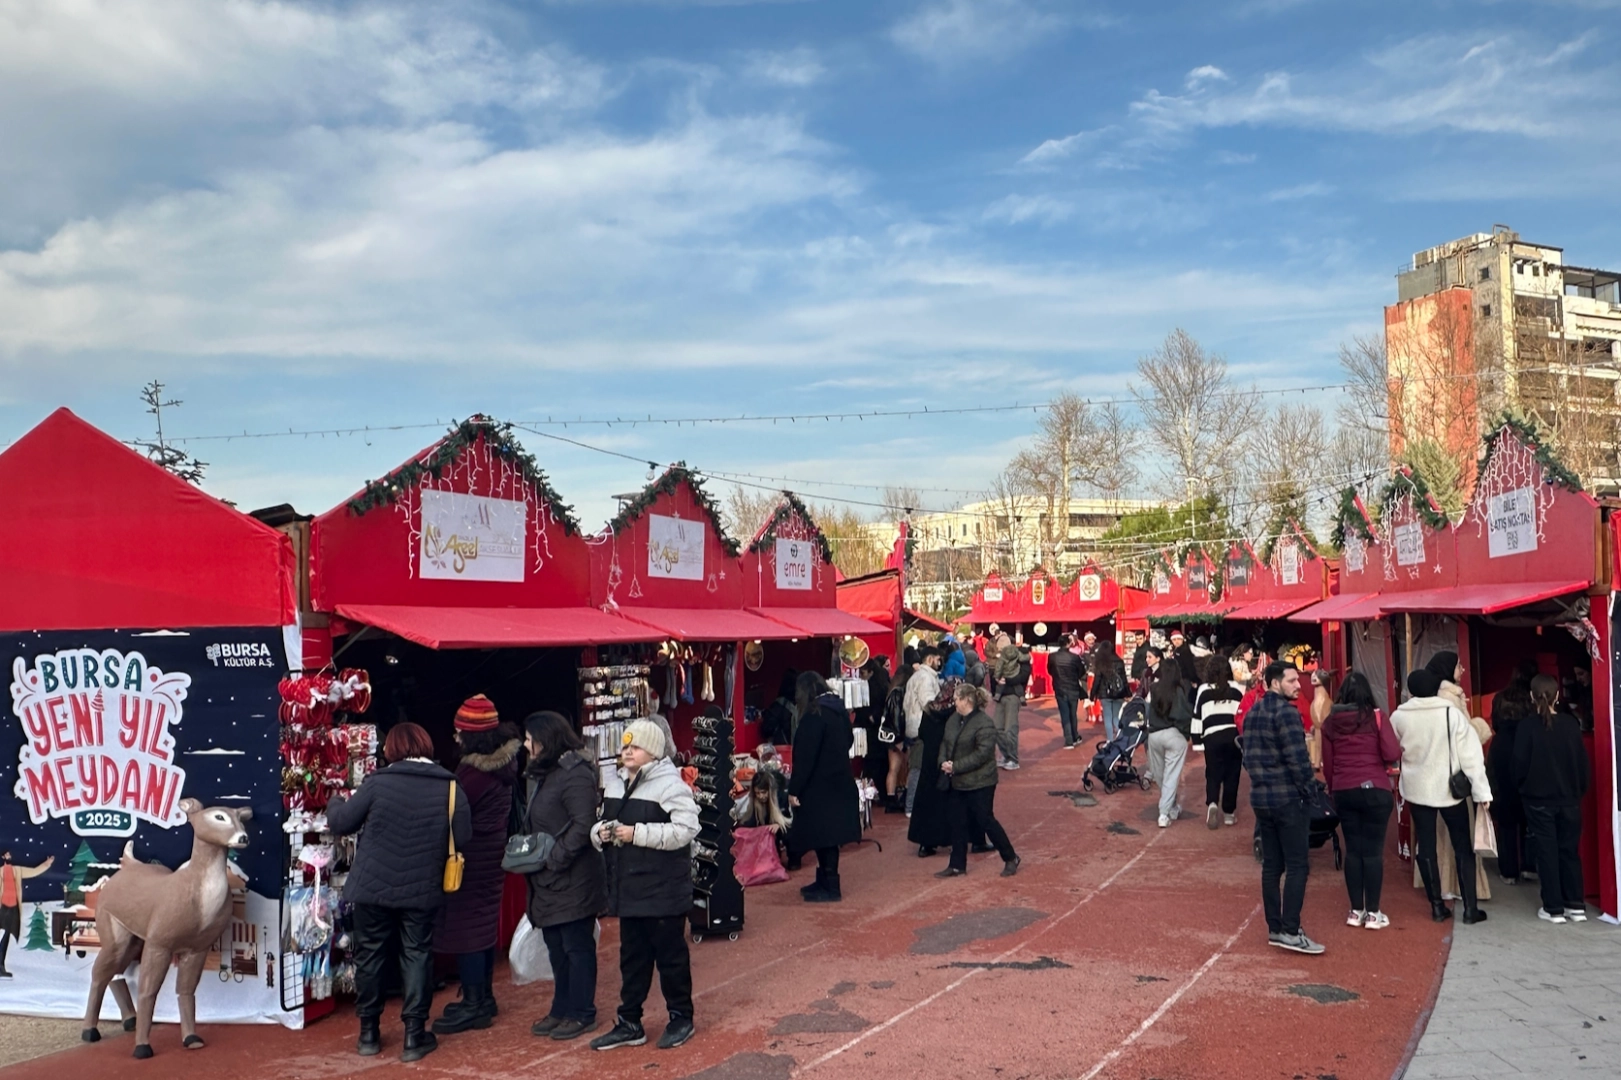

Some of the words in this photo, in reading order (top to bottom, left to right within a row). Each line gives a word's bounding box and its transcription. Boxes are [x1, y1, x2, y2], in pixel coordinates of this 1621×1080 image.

[221, 643, 271, 657] BURSA
[224, 657, 257, 667] KÜLTÜR
[258, 658, 275, 668] A.Ş.
[41, 655, 142, 693] BURSA
[118, 694, 169, 761] YIL
[24, 754, 180, 822] MEYDANI
[86, 813, 121, 827] 2025
